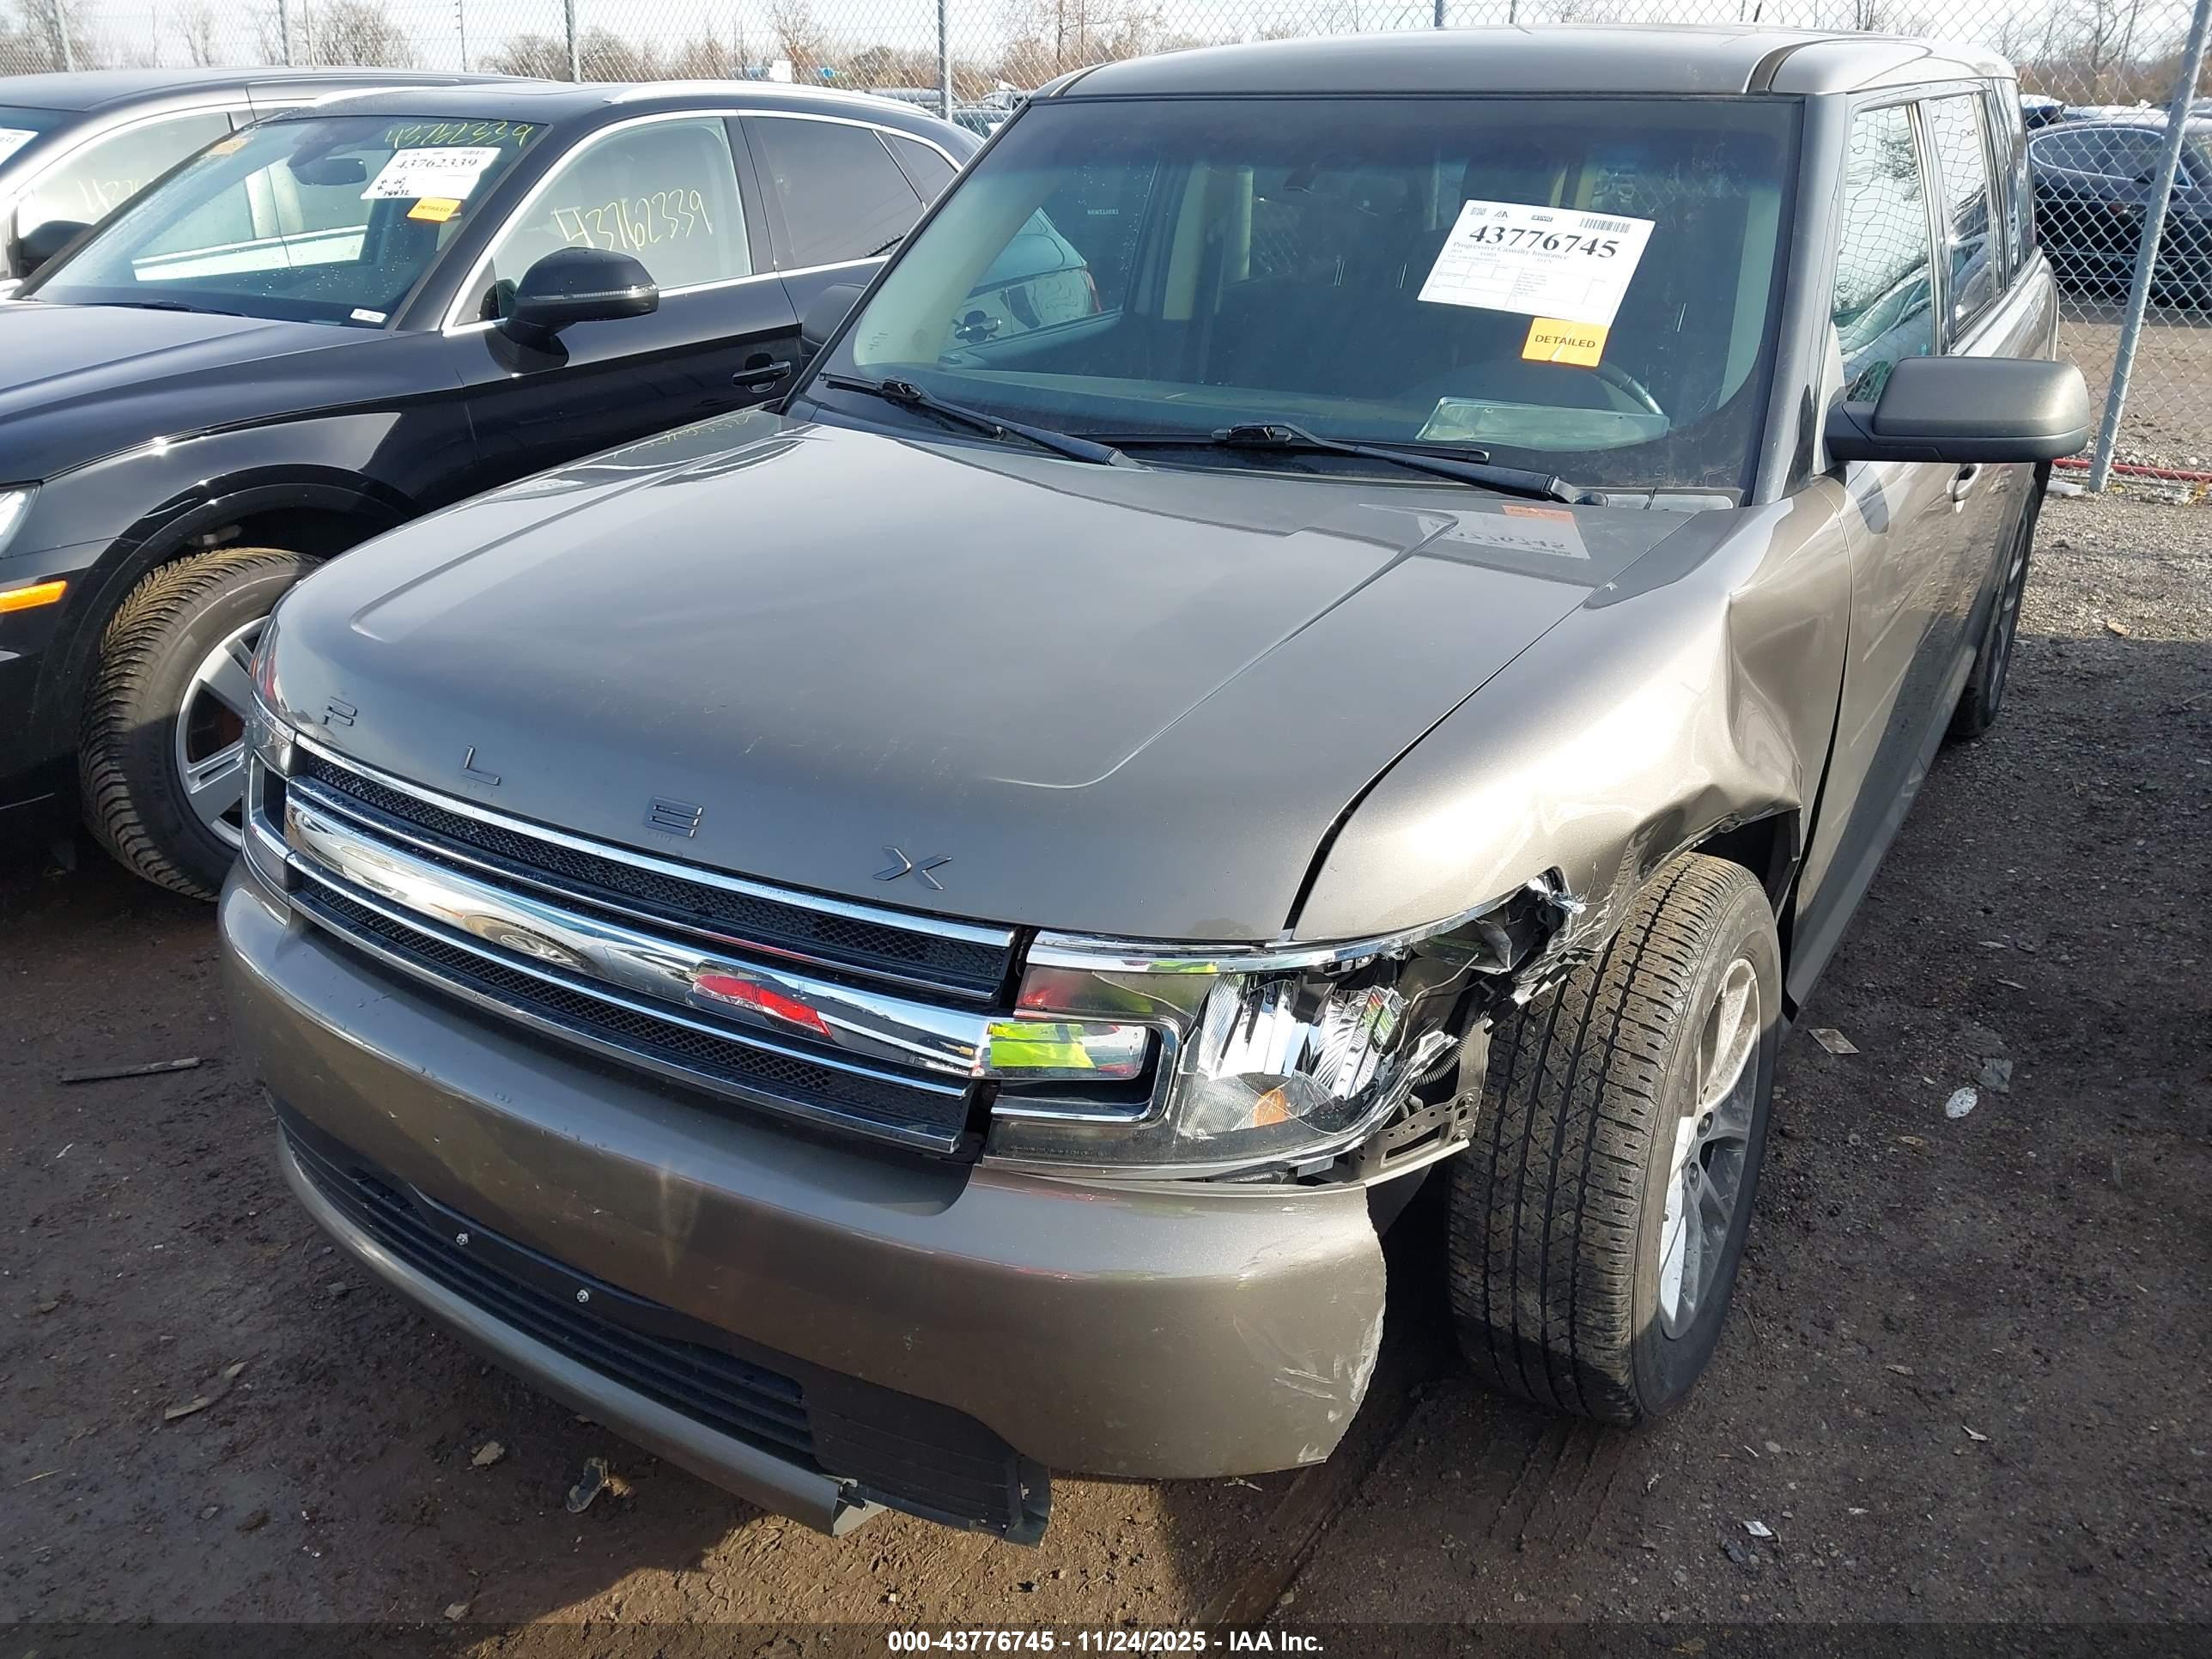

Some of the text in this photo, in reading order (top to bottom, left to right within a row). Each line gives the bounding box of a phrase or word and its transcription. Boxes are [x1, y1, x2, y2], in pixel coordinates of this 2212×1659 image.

[385, 121, 533, 149] 43762339
[398, 158, 478, 169] 43762339
[550, 189, 712, 251] 43762339
[1453, 241, 1497, 252] Progressive
[1498, 246, 1529, 255] Casualty
[1532, 250, 1570, 260] Insurance
[1468, 225, 1621, 258] 43776745
[1534, 333, 1596, 349] DETAILED
